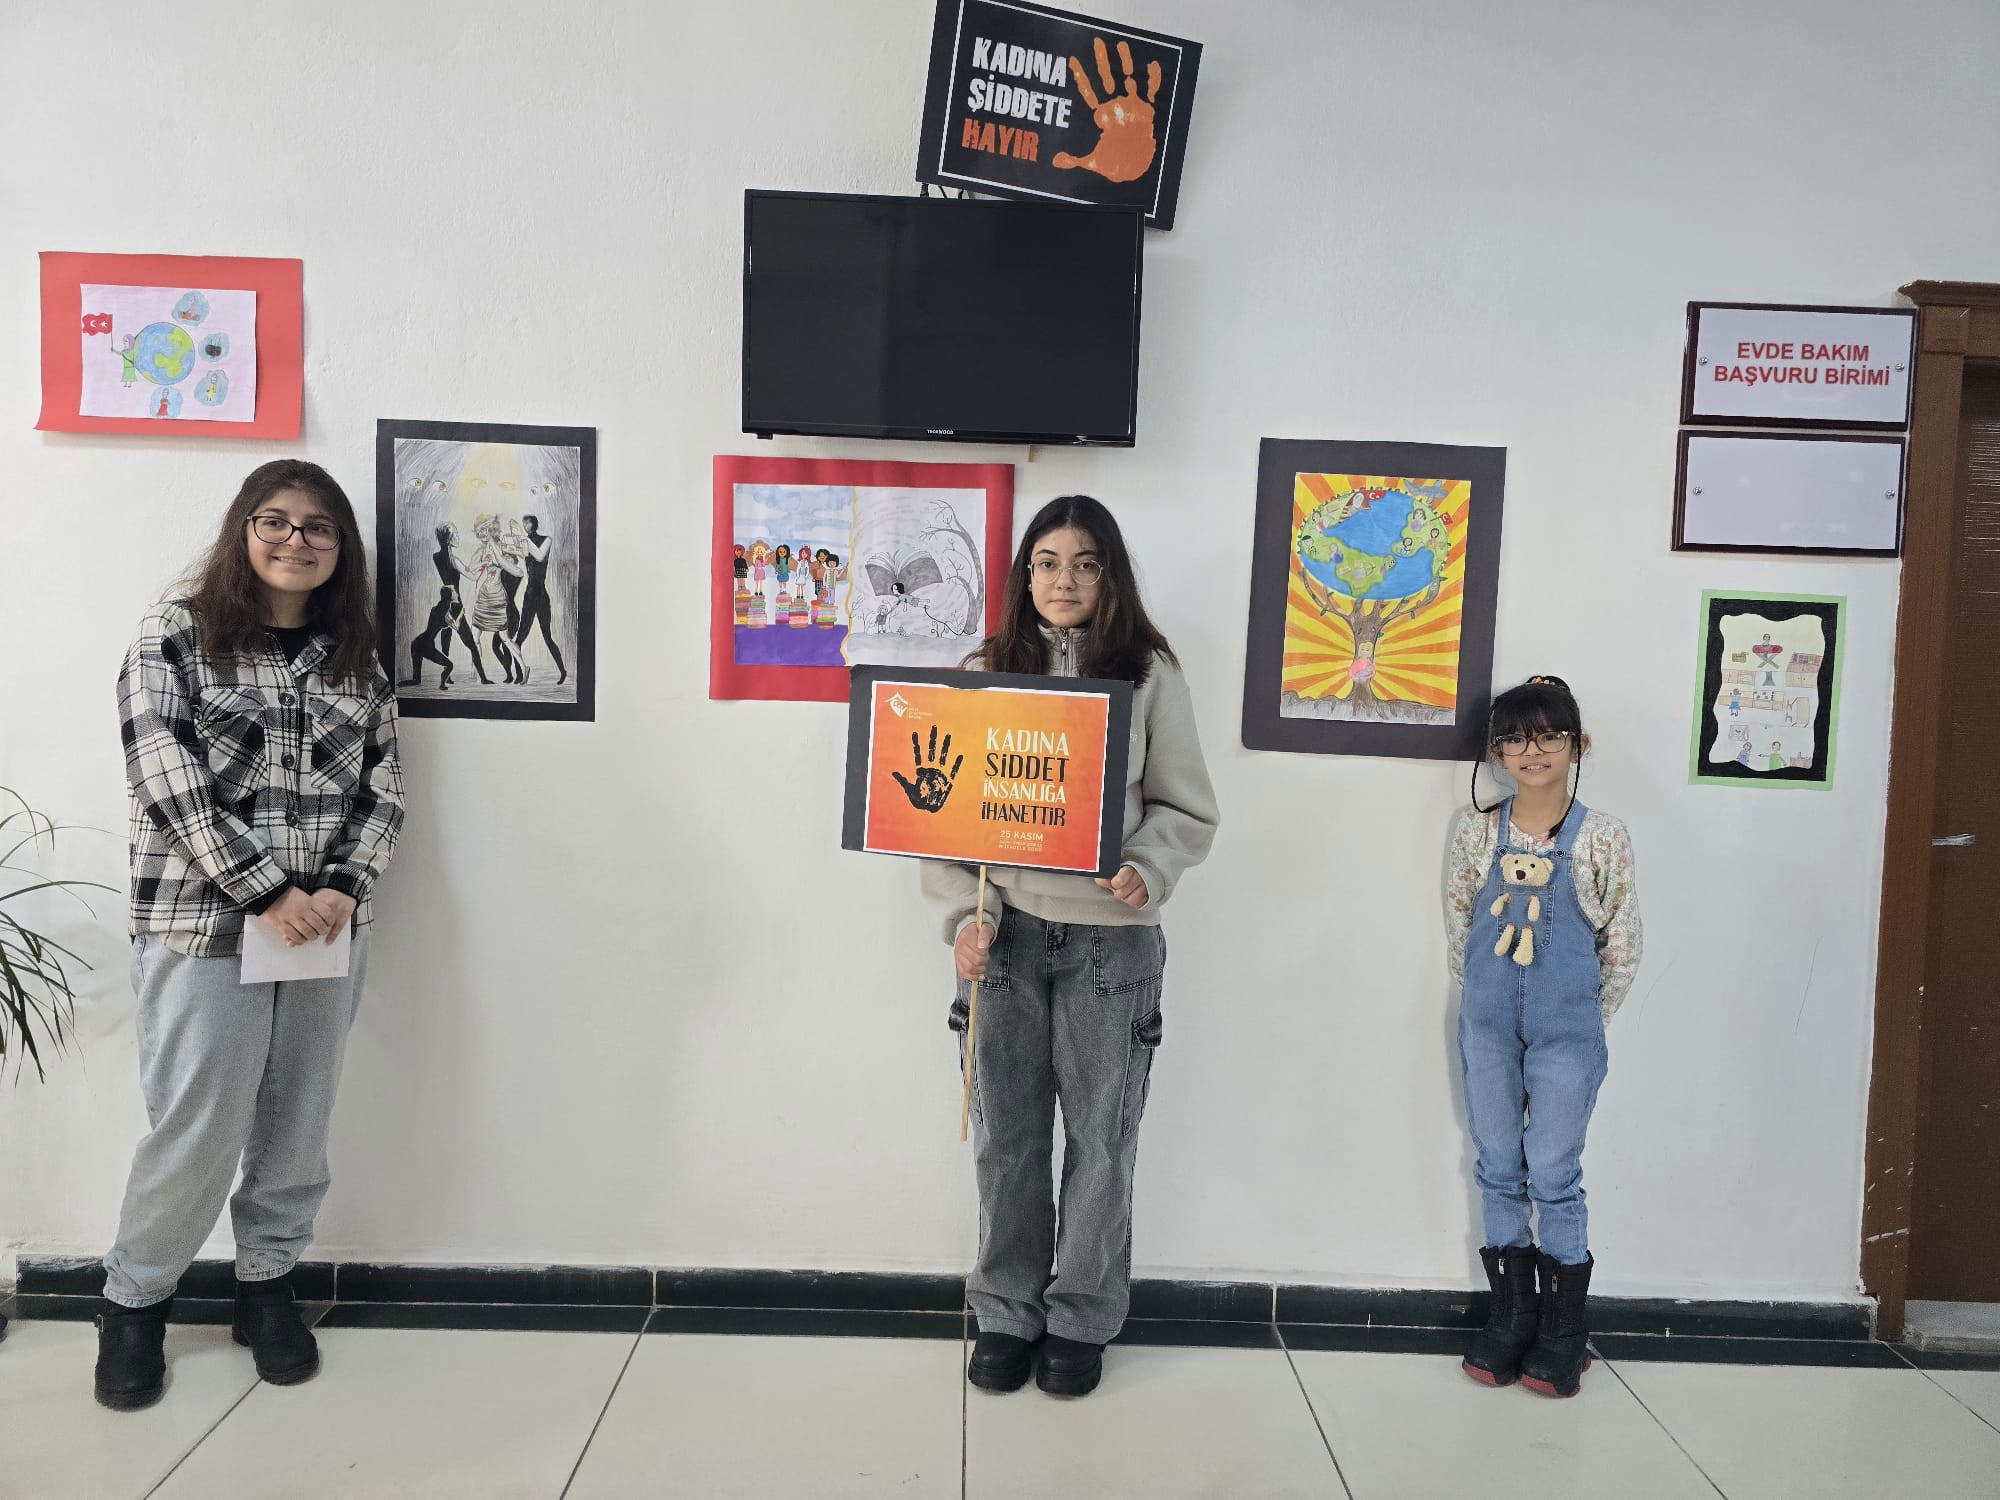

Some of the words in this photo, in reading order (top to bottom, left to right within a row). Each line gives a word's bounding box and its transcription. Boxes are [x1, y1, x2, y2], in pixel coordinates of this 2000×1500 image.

[972, 36, 1067, 87] KADINA
[968, 75, 1072, 128] ŞİDDETE
[961, 118, 1039, 161] HAYIR
[1737, 342, 1794, 361] EVDE
[1800, 343, 1869, 361] BAKIM
[1714, 365, 1818, 386] BAŞVURU
[1825, 365, 1890, 386] BİRİMİ
[986, 727, 1069, 756] KADINA
[983, 779, 1066, 804] İNSANLIĞA
[981, 801, 1066, 827] İHANETTİR
[1000, 830, 1011, 838] 25
[1013, 831, 1043, 841] KASIM
